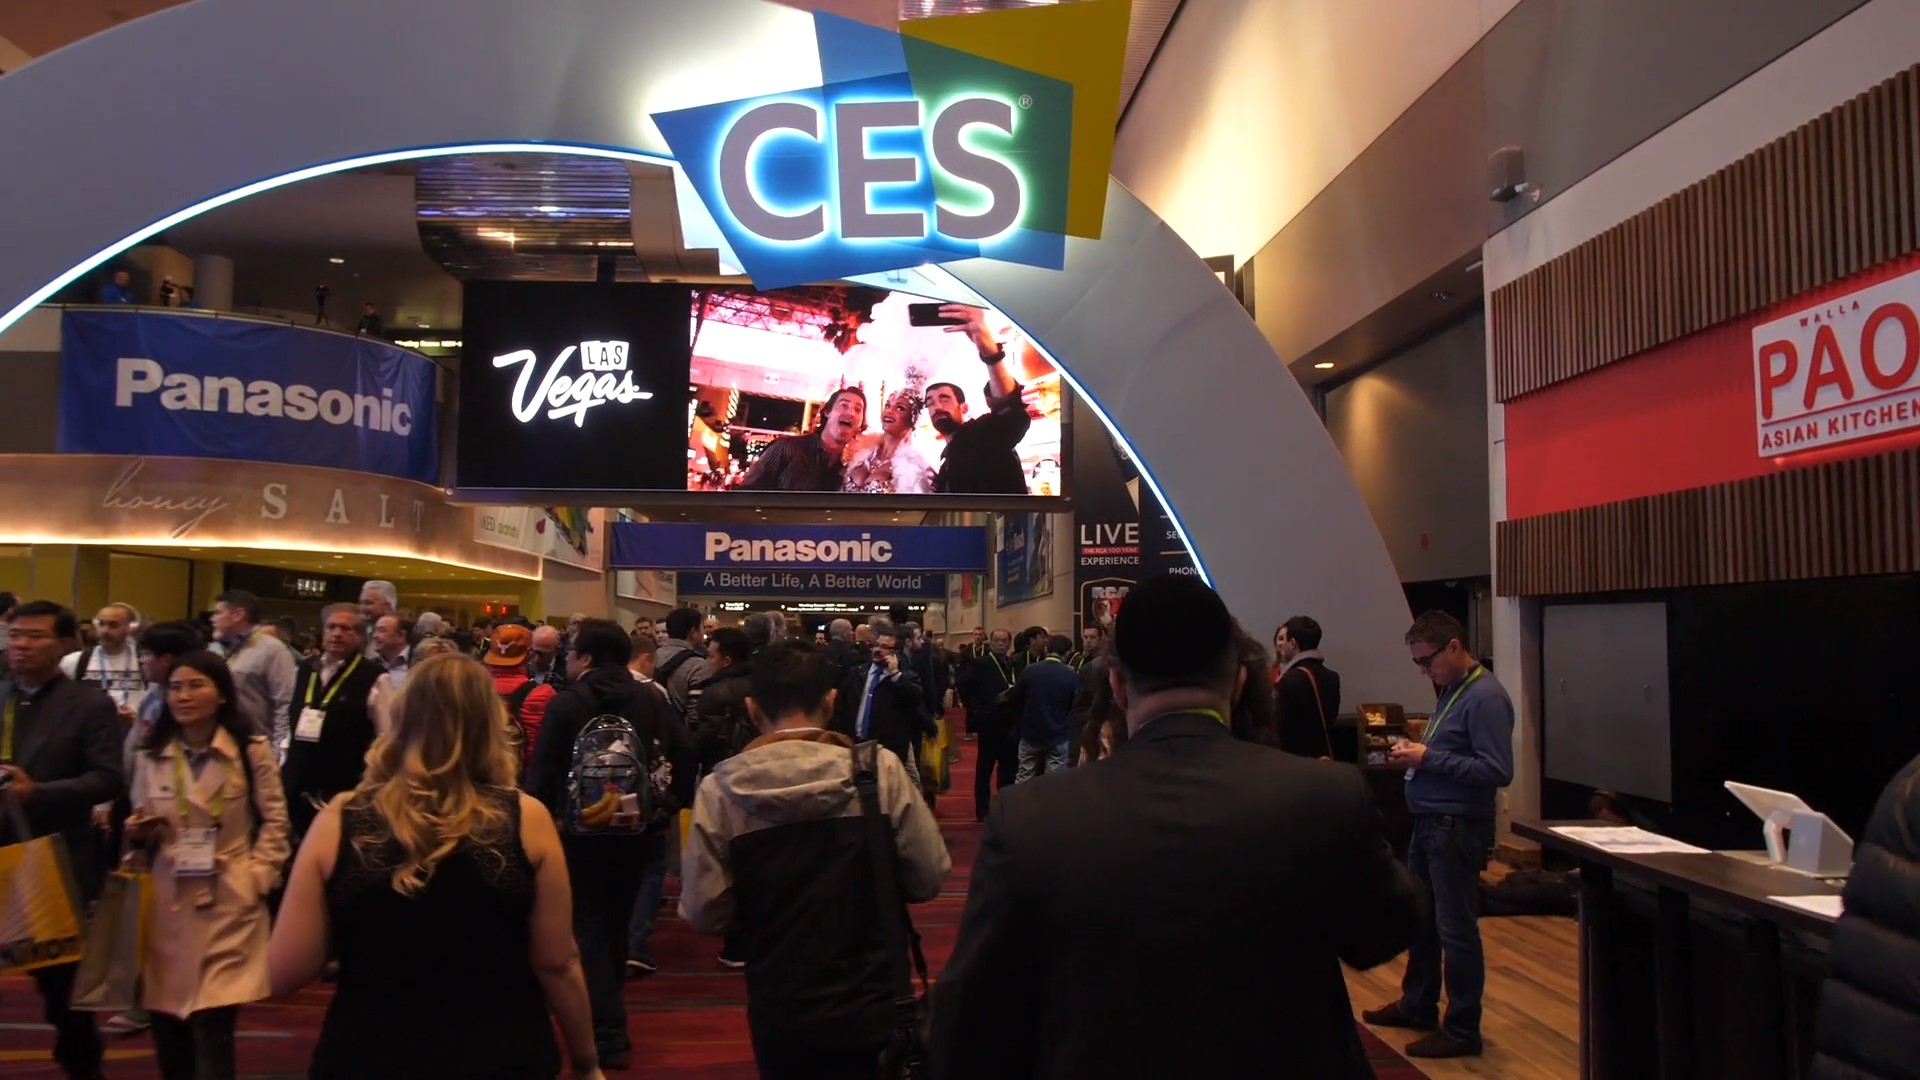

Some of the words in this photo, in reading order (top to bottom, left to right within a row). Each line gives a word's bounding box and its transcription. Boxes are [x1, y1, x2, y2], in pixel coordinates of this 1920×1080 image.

[720, 98, 1021, 240] CES
[1799, 300, 1860, 328] WALLA
[587, 345, 623, 367] LAS
[1759, 302, 1920, 420] PAO
[115, 357, 412, 436] Panasonic
[492, 345, 654, 428] Vegas
[1762, 421, 1819, 450] ASIAN
[1828, 398, 1920, 435] KITCHEN
[102, 457, 228, 539] honey
[261, 483, 425, 532] SALT
[705, 531, 893, 562] Panasonic
[1081, 523, 1139, 545] LIVE
[1081, 556, 1140, 566] EXPERIENCE
[1169, 566, 1199, 575] PHON
[704, 573, 715, 587] A
[720, 573, 767, 588] Better
[772, 574, 804, 590] Life,
[809, 575, 821, 588] A
[825, 575, 871, 589] Better
[876, 575, 922, 590] World
[1092, 586, 1129, 600] RCA
